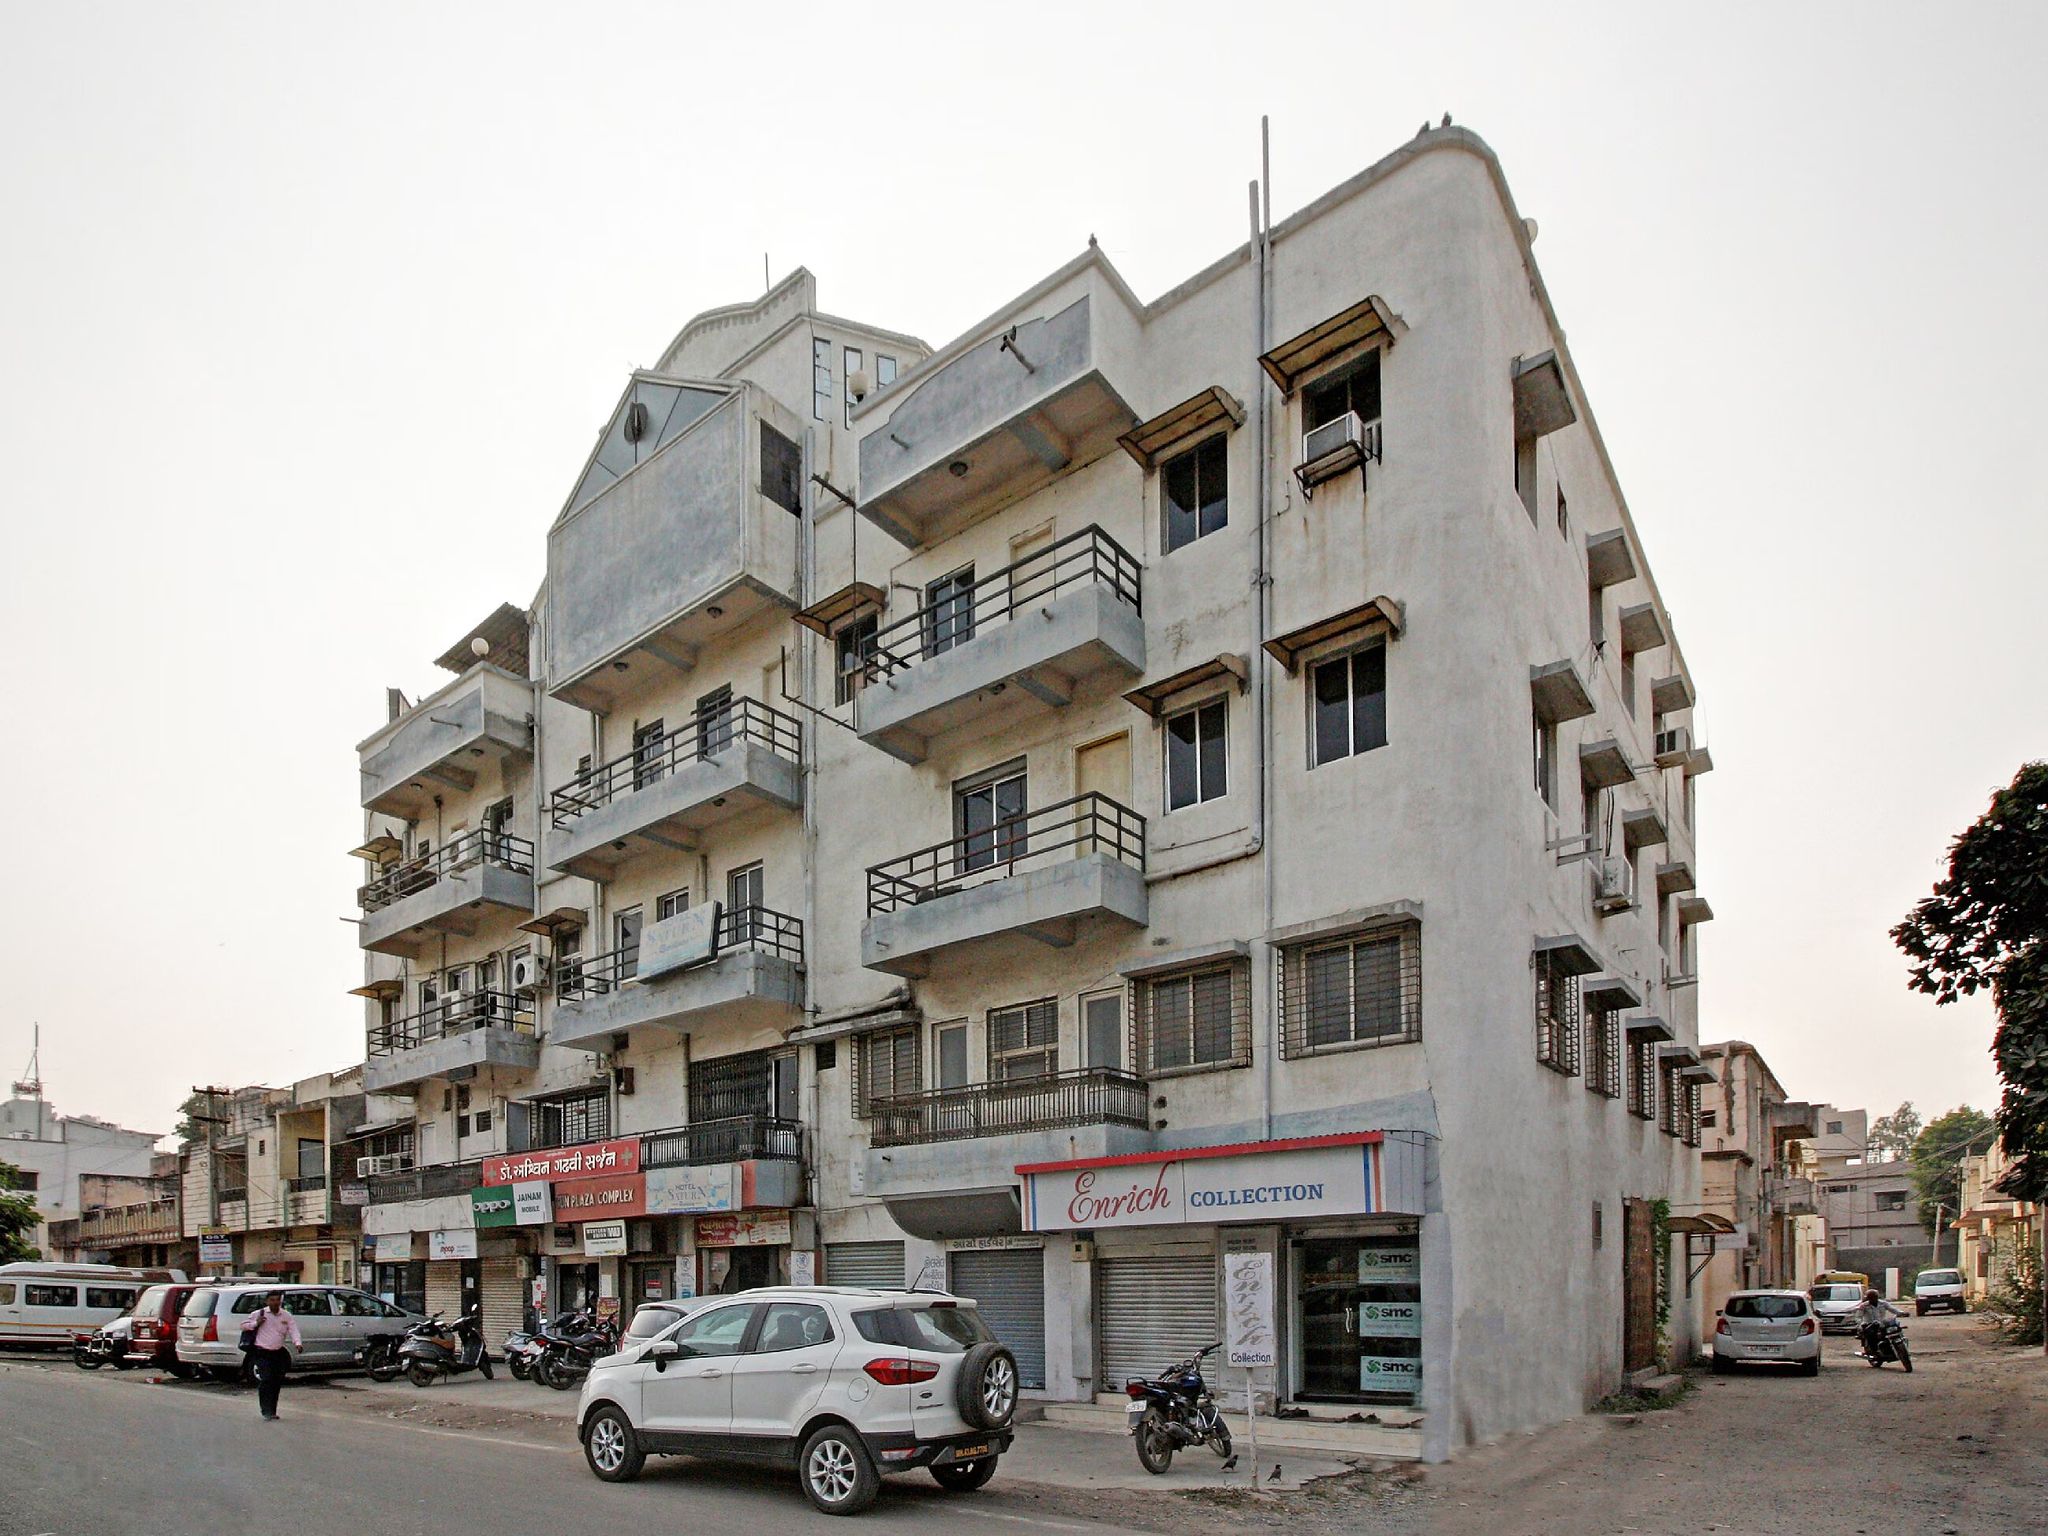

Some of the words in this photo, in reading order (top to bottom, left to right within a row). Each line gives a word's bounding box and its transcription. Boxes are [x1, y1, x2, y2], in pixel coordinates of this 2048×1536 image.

[554, 1152, 582, 1173] गढवी
[585, 1145, 616, 1170] सर्जन
[675, 1183, 696, 1191] HOTEL
[1067, 1160, 1177, 1223] Enrich
[517, 1191, 543, 1202] JAINAM
[570, 1193, 595, 1208] PLAZA
[597, 1188, 634, 1204] COMPLEX
[1190, 1183, 1325, 1208] COLLECTION
[521, 1204, 540, 1213] MOBILE
[1379, 1253, 1412, 1264] smc
[1380, 1307, 1413, 1318] smc
[1230, 1352, 1272, 1364] Collection
[1381, 1361, 1414, 1373] smc
